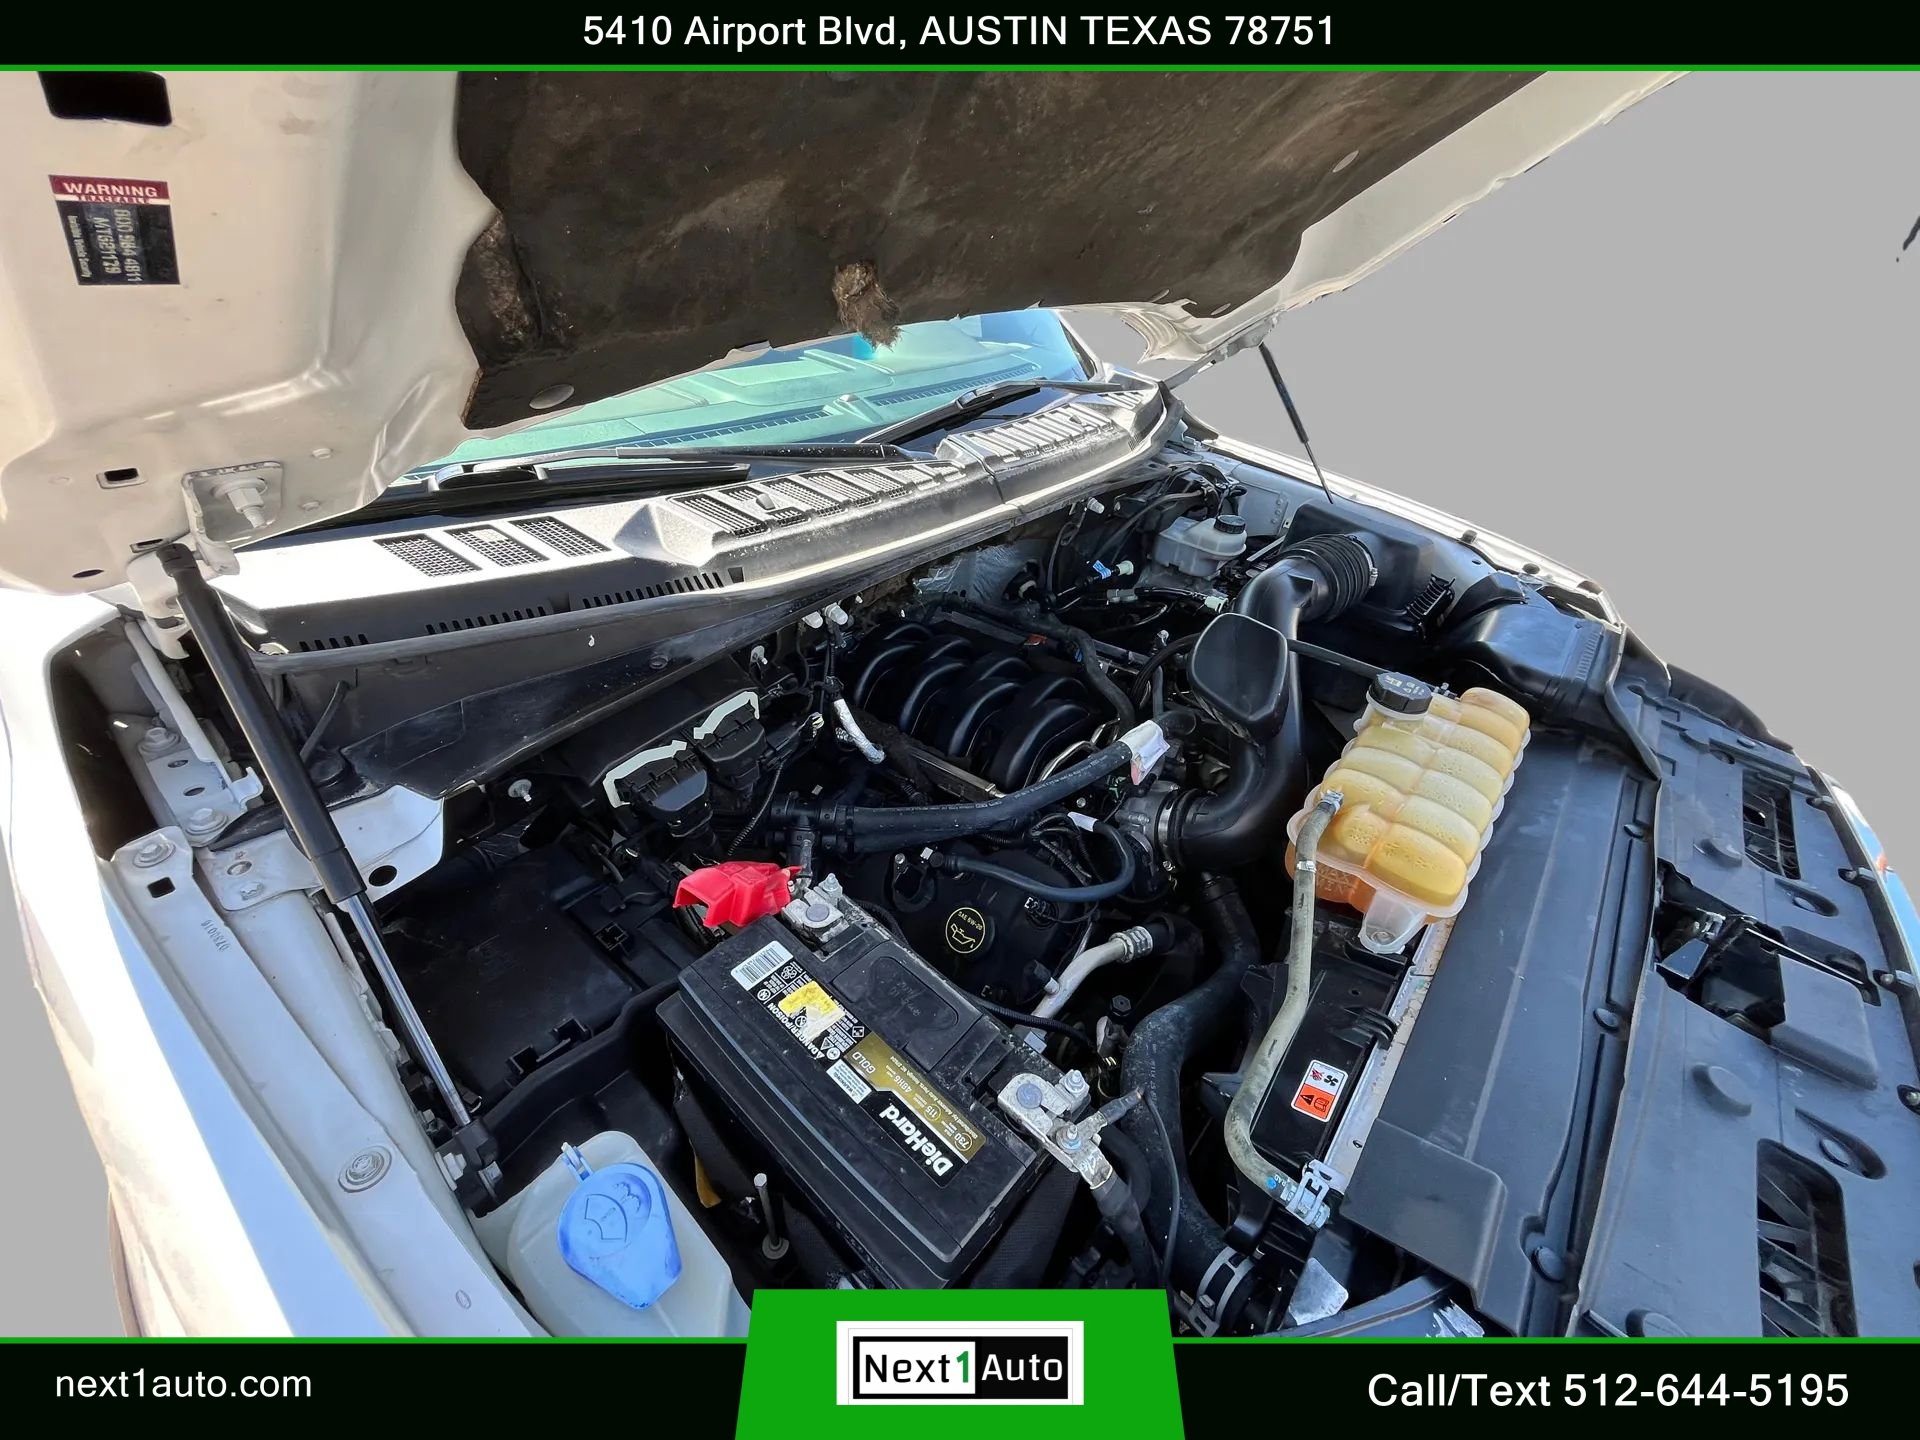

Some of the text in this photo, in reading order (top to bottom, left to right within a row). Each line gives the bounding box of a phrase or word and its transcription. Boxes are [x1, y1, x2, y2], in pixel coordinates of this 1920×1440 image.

[63, 182, 158, 197] WARNING
[767, 1003, 820, 1055] DANGER/POISON
[851, 1050, 876, 1074] GOLD
[924, 1104, 938, 1118] 115
[878, 1103, 954, 1177] DieHard
[953, 1132, 970, 1148] 730
